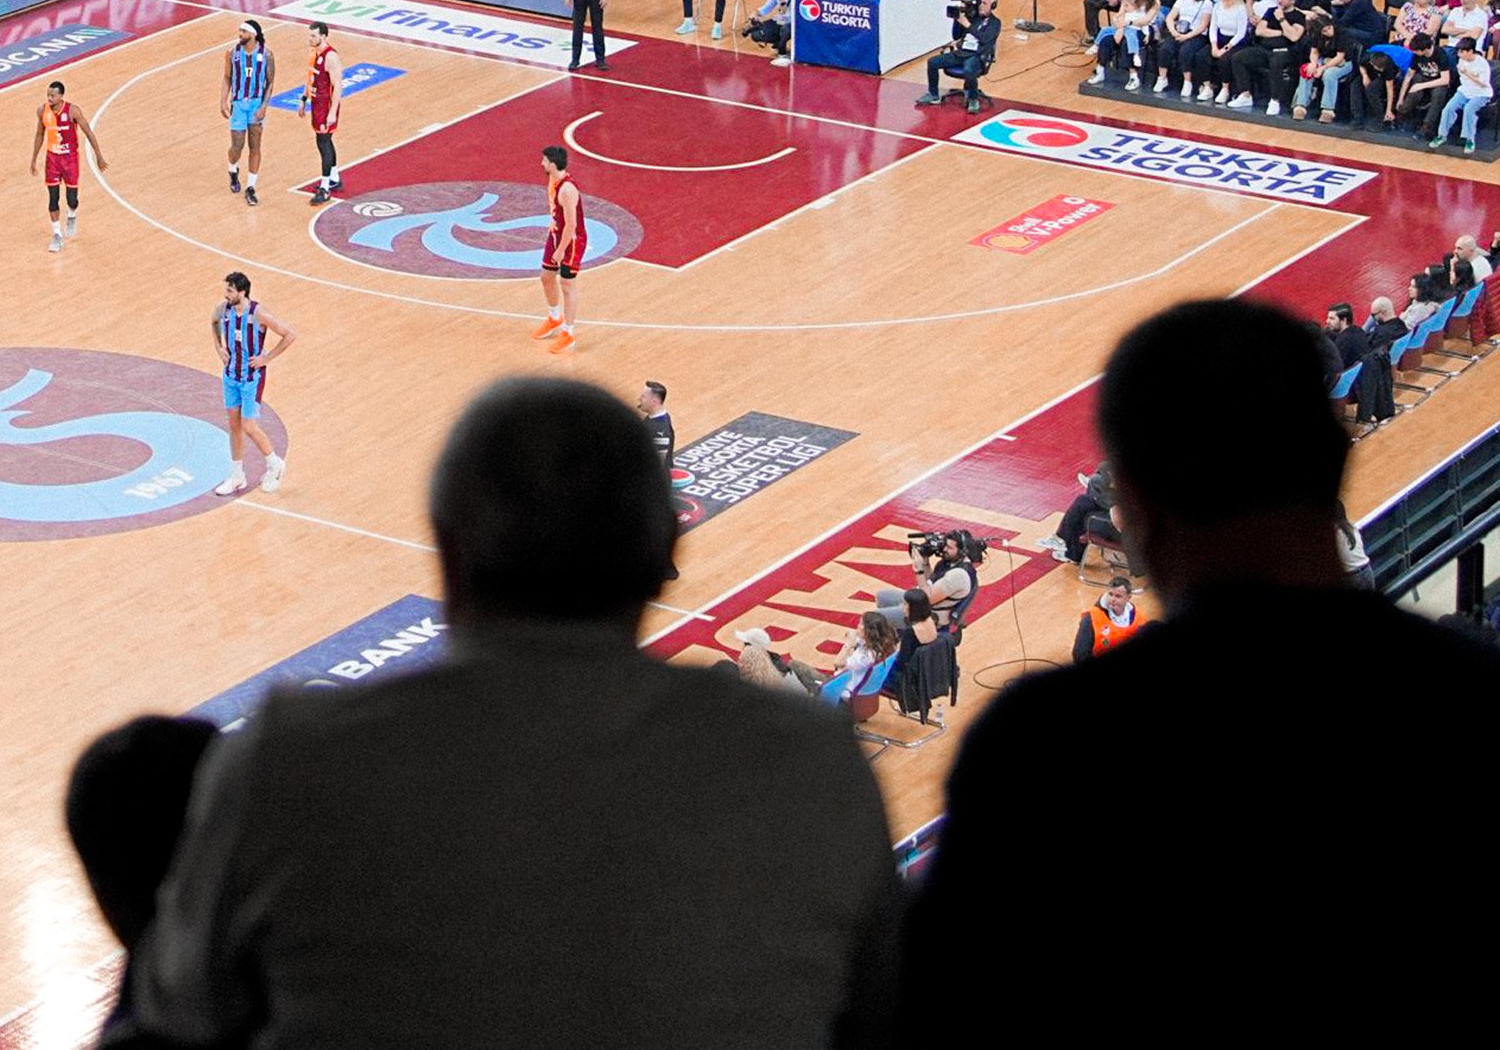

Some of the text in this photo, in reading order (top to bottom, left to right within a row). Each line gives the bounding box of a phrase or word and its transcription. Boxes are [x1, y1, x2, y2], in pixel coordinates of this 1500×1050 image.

[372, 8, 554, 51] finans
[1008, 217, 1043, 233] Shell
[1025, 203, 1102, 236] V-Power
[123, 466, 194, 499] 1967
[681, 435, 808, 497] BASKETBOL
[711, 463, 791, 503] SÜPER
[327, 617, 450, 680] BANK
